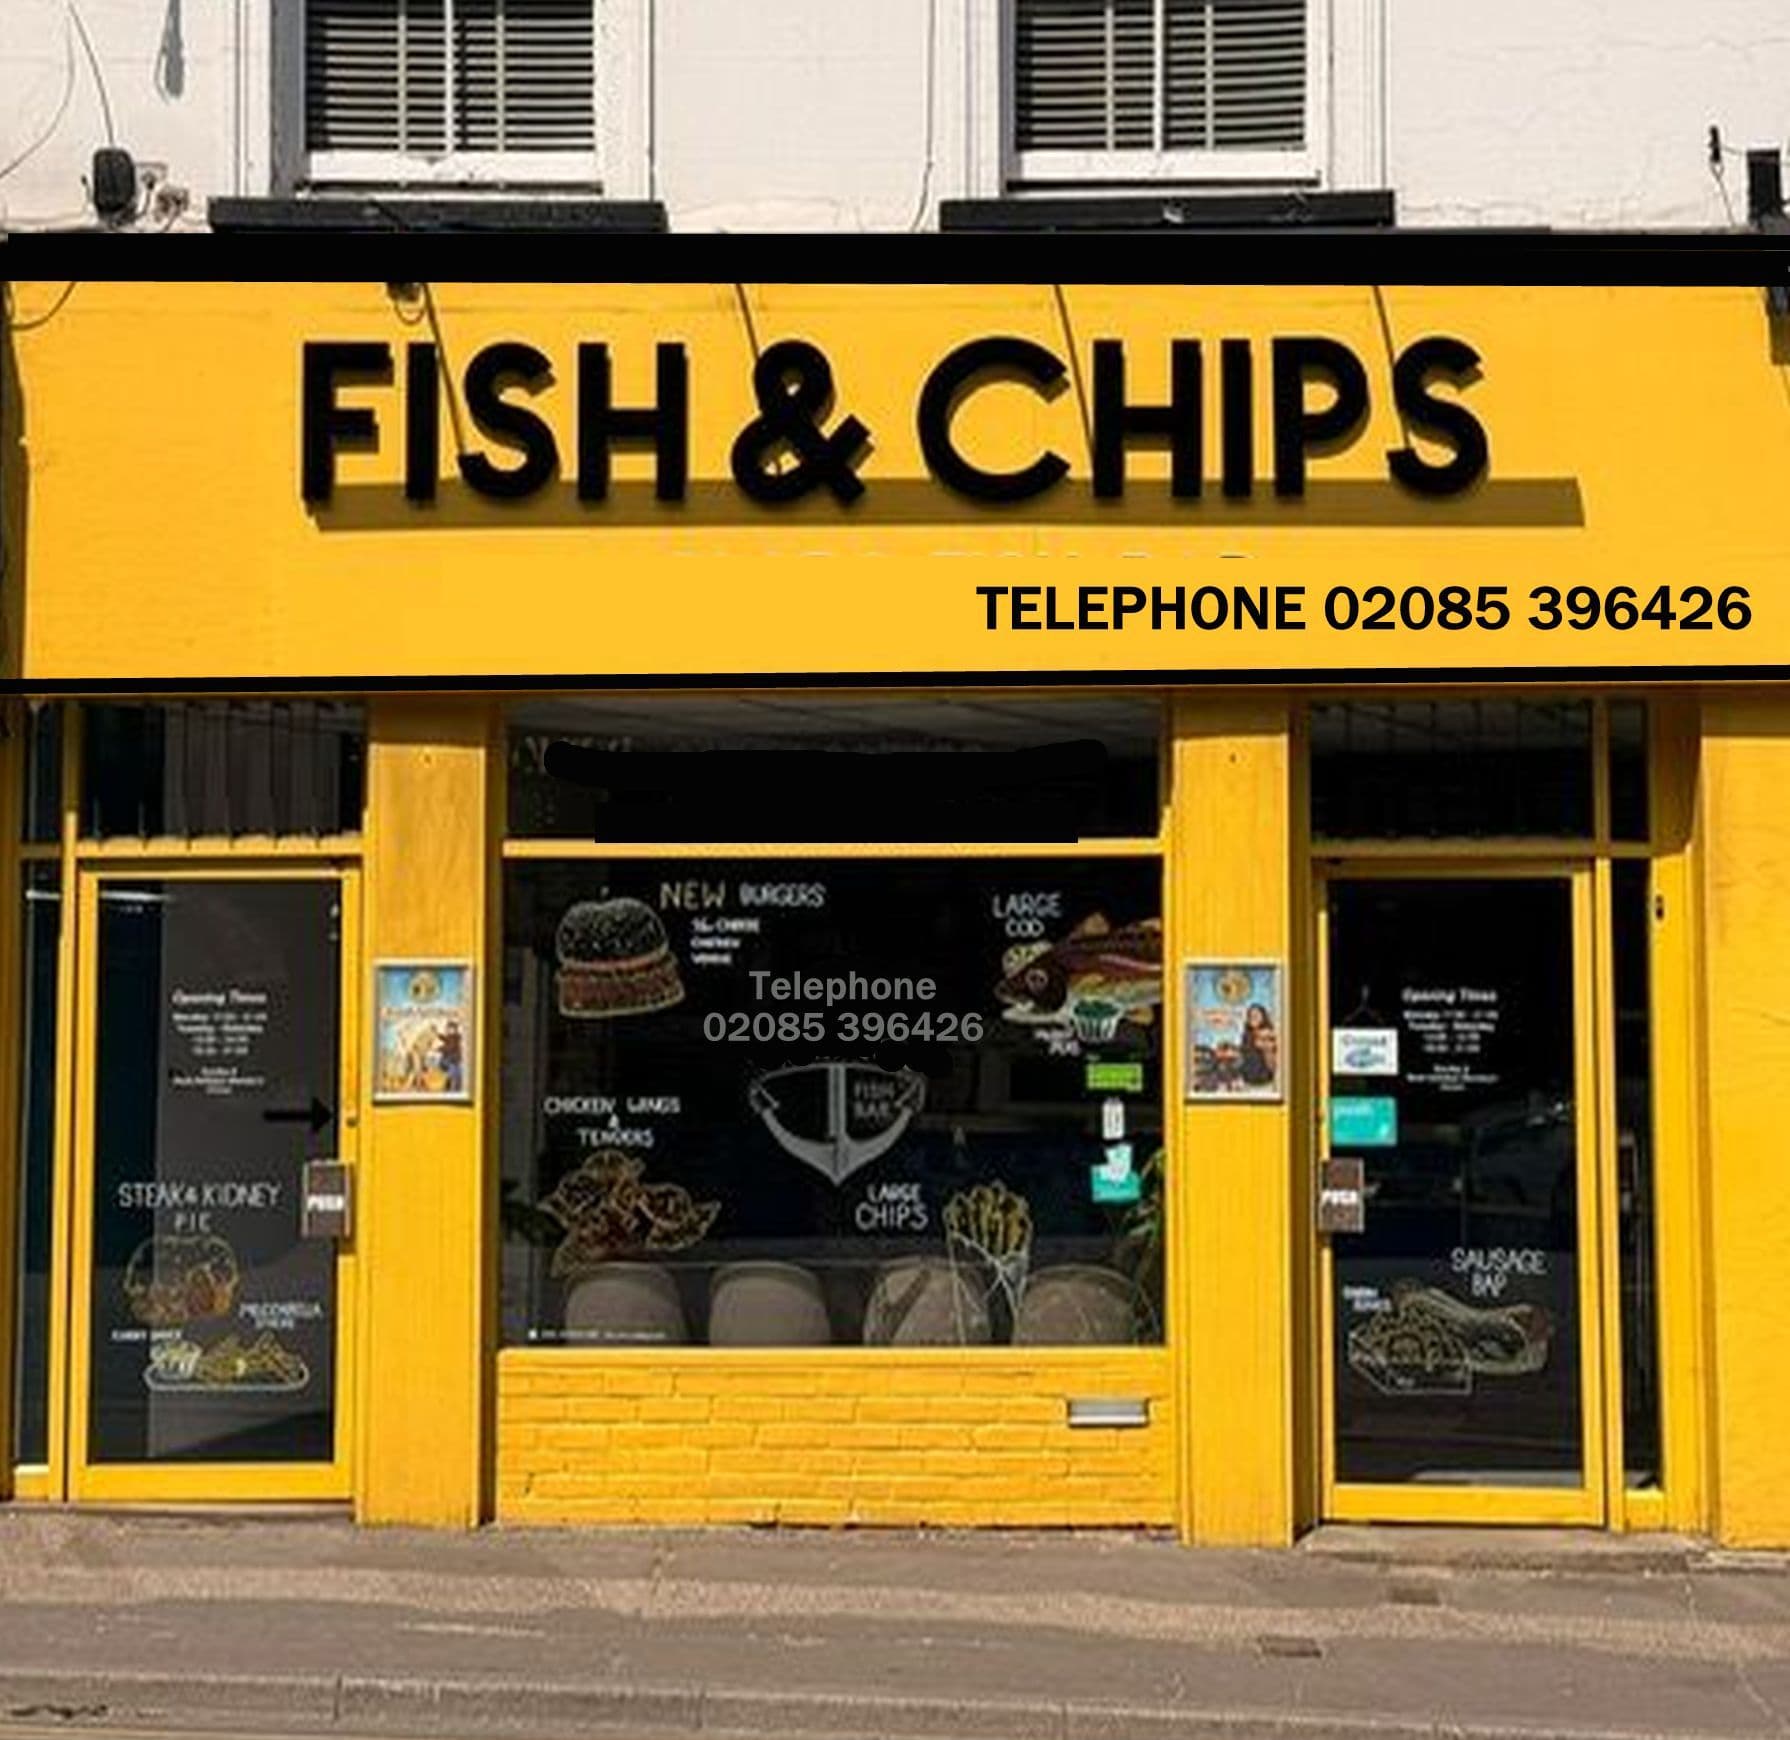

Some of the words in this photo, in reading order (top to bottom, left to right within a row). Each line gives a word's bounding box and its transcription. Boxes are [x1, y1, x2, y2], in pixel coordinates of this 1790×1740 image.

[302, 340, 560, 505] FISH
[731, 338, 874, 508] &
[917, 336, 1490, 504] CHIPS
[976, 585, 1306, 630] TELEPHONE
[1324, 585, 1510, 631] 02085
[1528, 585, 1752, 631] 396426
[660, 882, 726, 911] NEW
[992, 893, 1062, 919] LARGE
[749, 971, 937, 1006] Telephone
[703, 1012, 825, 1042] 02085
[837, 1012, 984, 1042] 396426
[543, 1097, 616, 1115] CHICKEN
[627, 1096, 682, 1115] WINGS
[866, 1184, 922, 1202] LARGE
[854, 1202, 929, 1231] CHIPS
[1451, 1247, 1547, 1275] SAUSAGE
